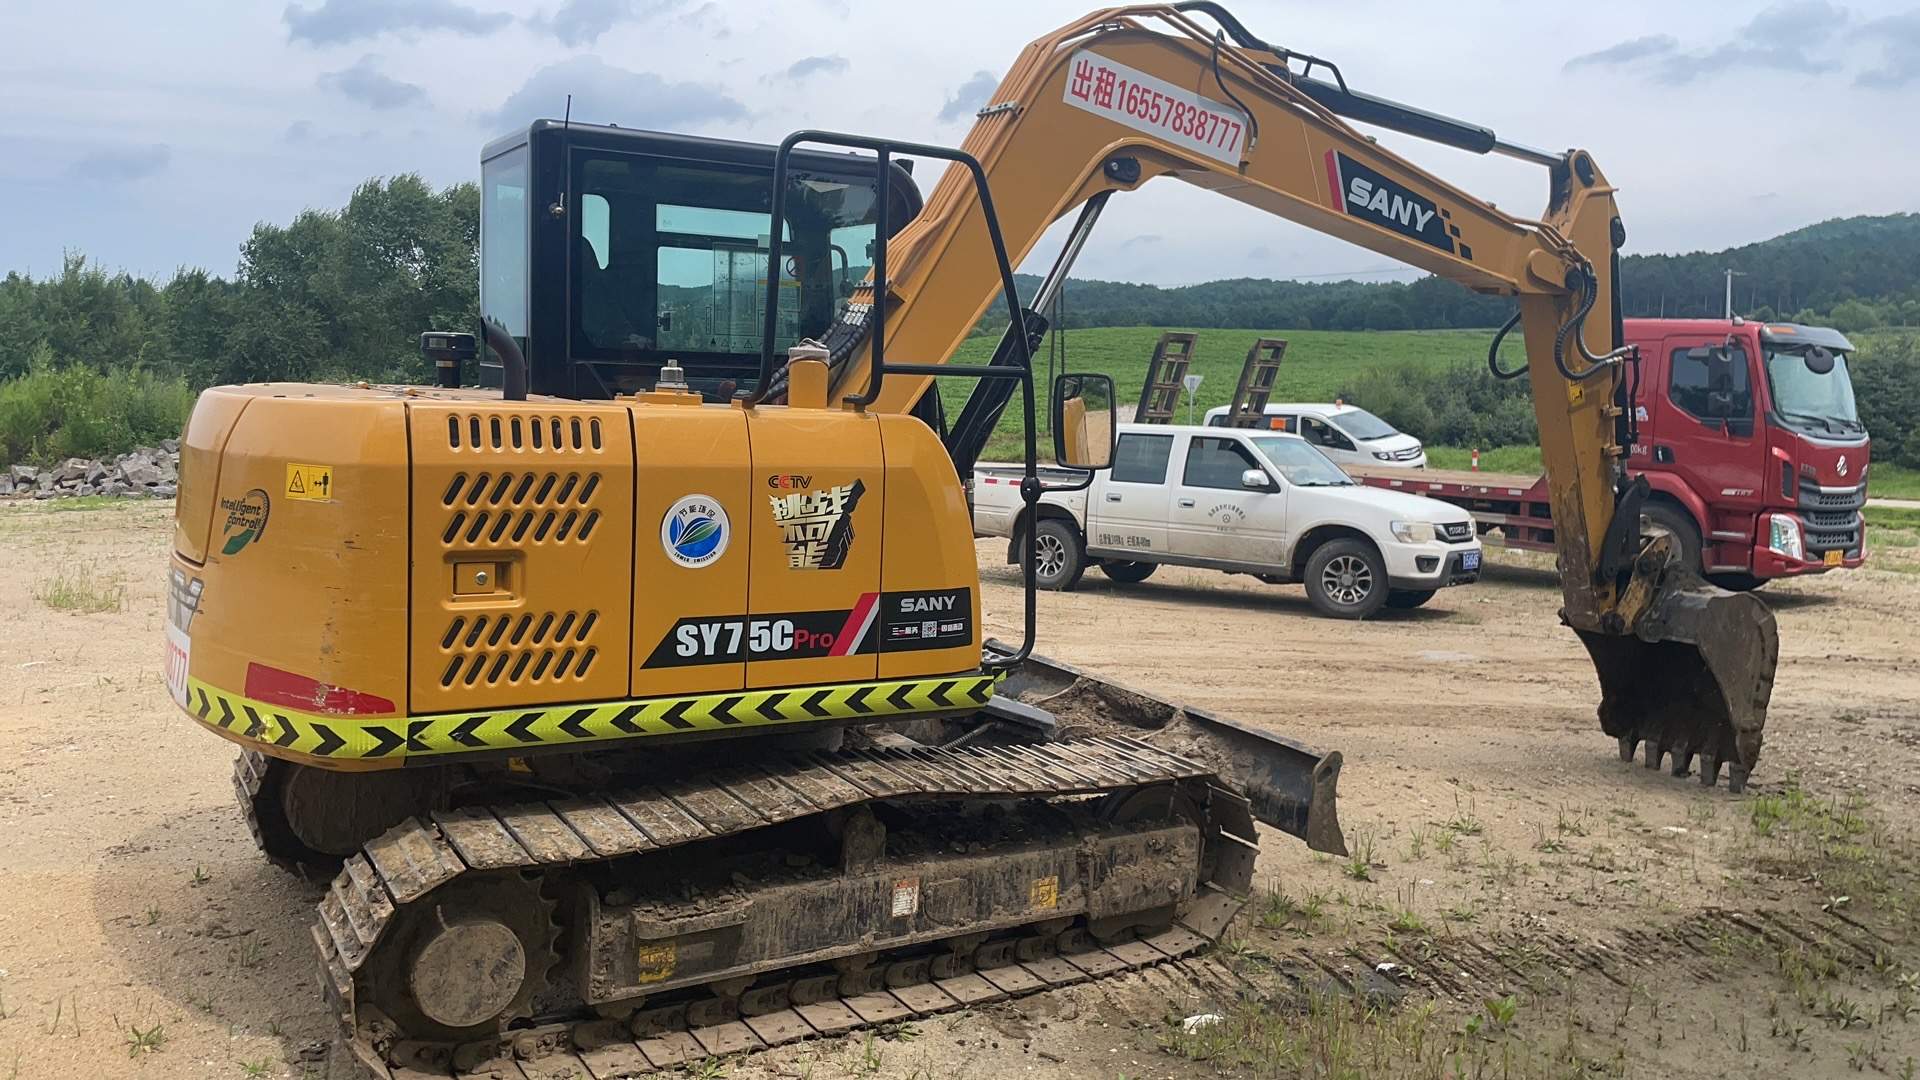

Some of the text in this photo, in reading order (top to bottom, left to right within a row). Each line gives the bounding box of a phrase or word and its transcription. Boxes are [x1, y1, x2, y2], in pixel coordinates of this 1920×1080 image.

[1348, 177, 1435, 232] SANY
[768, 475, 812, 489] CCTV
[221, 497, 262, 516] Intelligent
[227, 515, 259, 530] control
[900, 595, 956, 613] SANY
[793, 629, 834, 650] Pro
